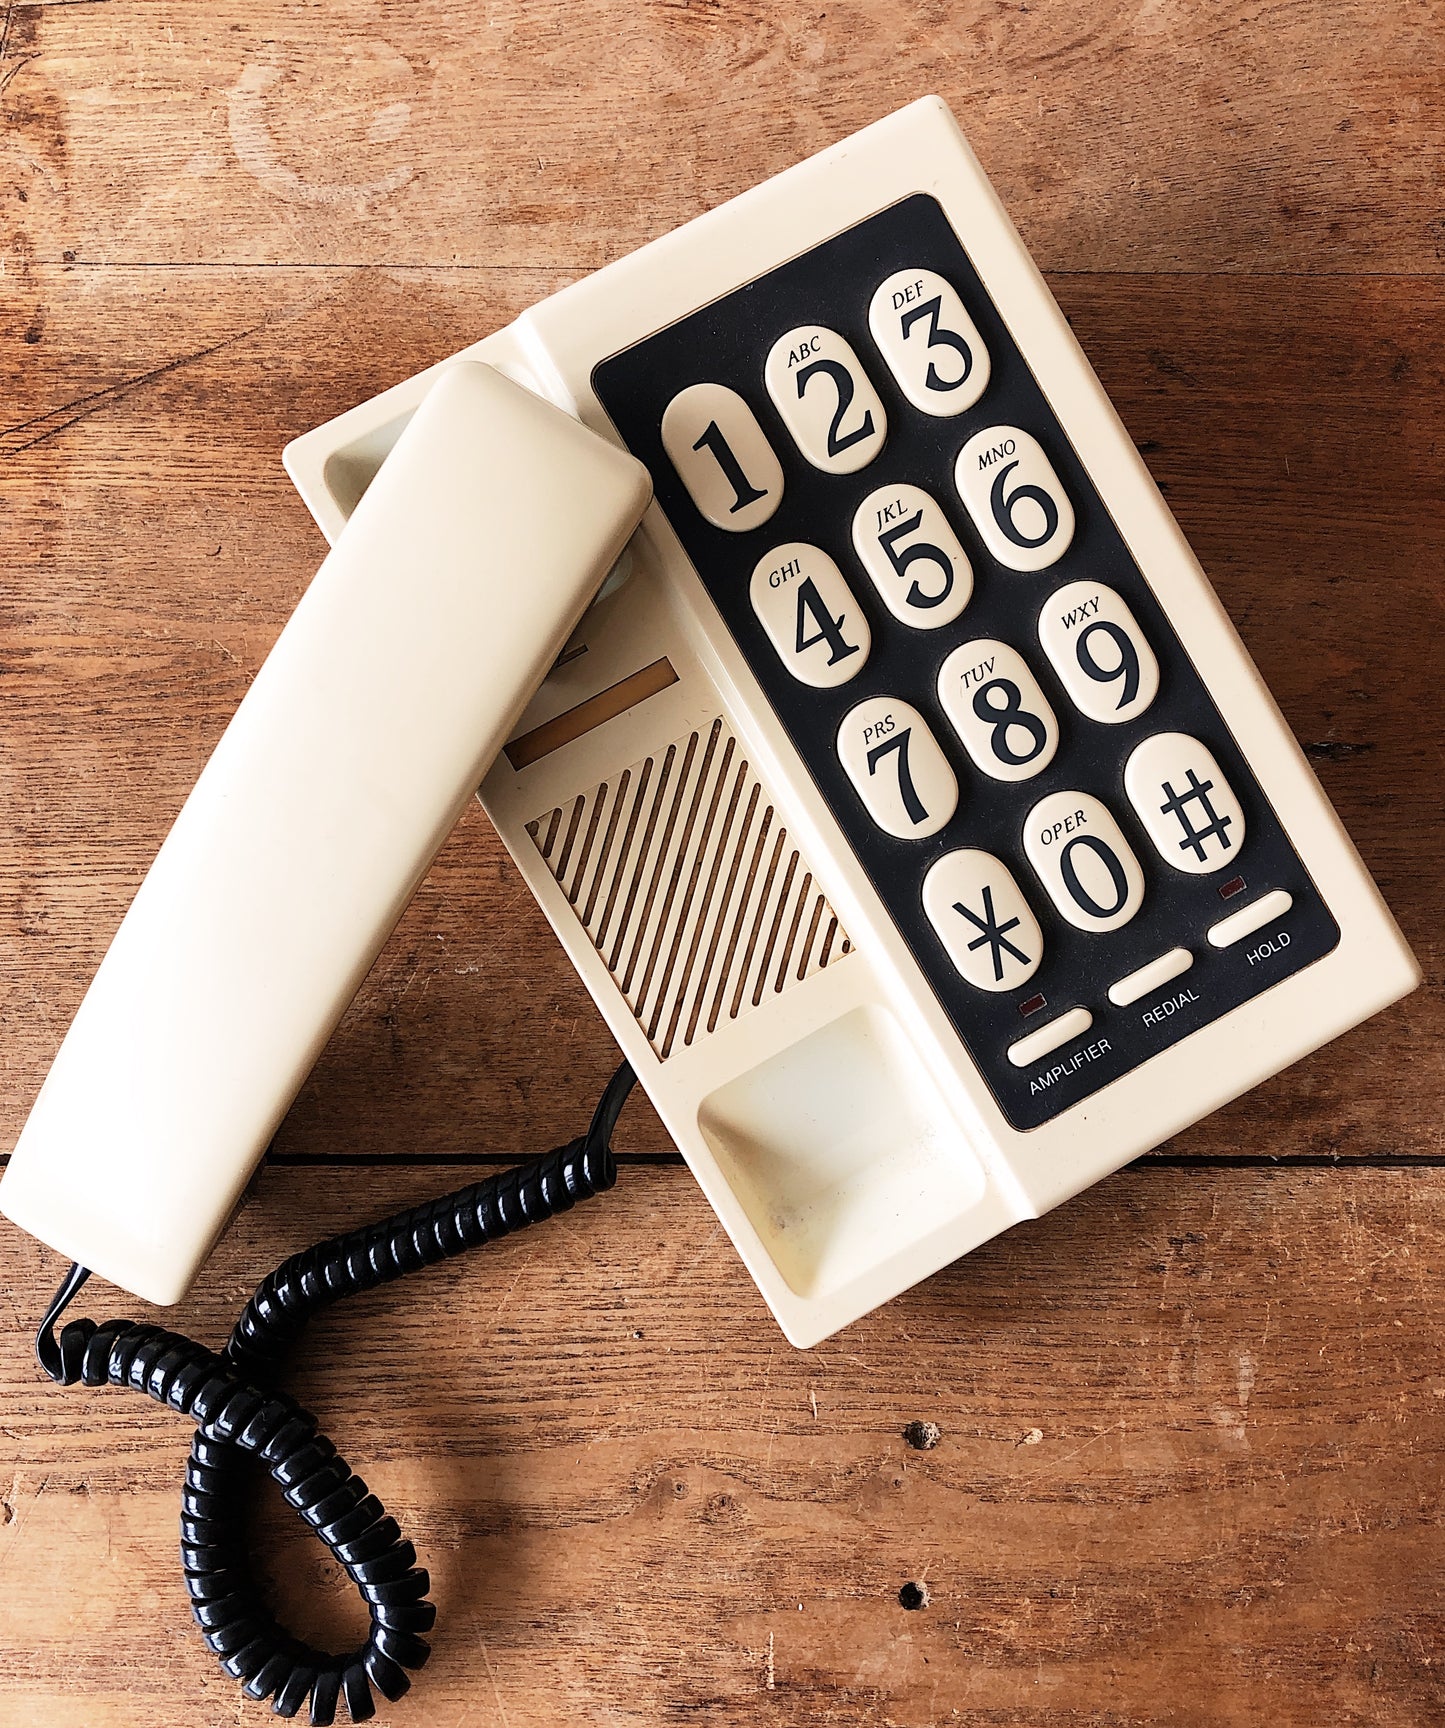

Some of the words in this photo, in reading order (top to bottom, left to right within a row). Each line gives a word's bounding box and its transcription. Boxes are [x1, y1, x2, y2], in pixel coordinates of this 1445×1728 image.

[891, 279, 923, 311] DEF
[787, 335, 821, 369] ABC
[900, 294, 973, 393] 3
[795, 359, 876, 458] 2
[691, 419, 769, 515] 1
[978, 439, 1016, 471] MNO
[876, 499, 908, 532] JKL
[989, 459, 1059, 549] 6
[768, 558, 801, 589] GHI
[877, 508, 954, 609] 5
[795, 575, 861, 667] 4
[1061, 595, 1099, 630] WXY
[960, 656, 995, 689] TUV
[1075, 620, 1140, 711] 9
[862, 714, 896, 746] PRS
[972, 677, 1048, 766] 8
[866, 727, 930, 826] 7
[1040, 809, 1088, 846] OPER
[1059, 834, 1129, 919] 0
[1246, 932, 1291, 966] HOLD
[1142, 989, 1200, 1028] REDIAL
[1029, 1038, 1112, 1096] AMPLIFIER
